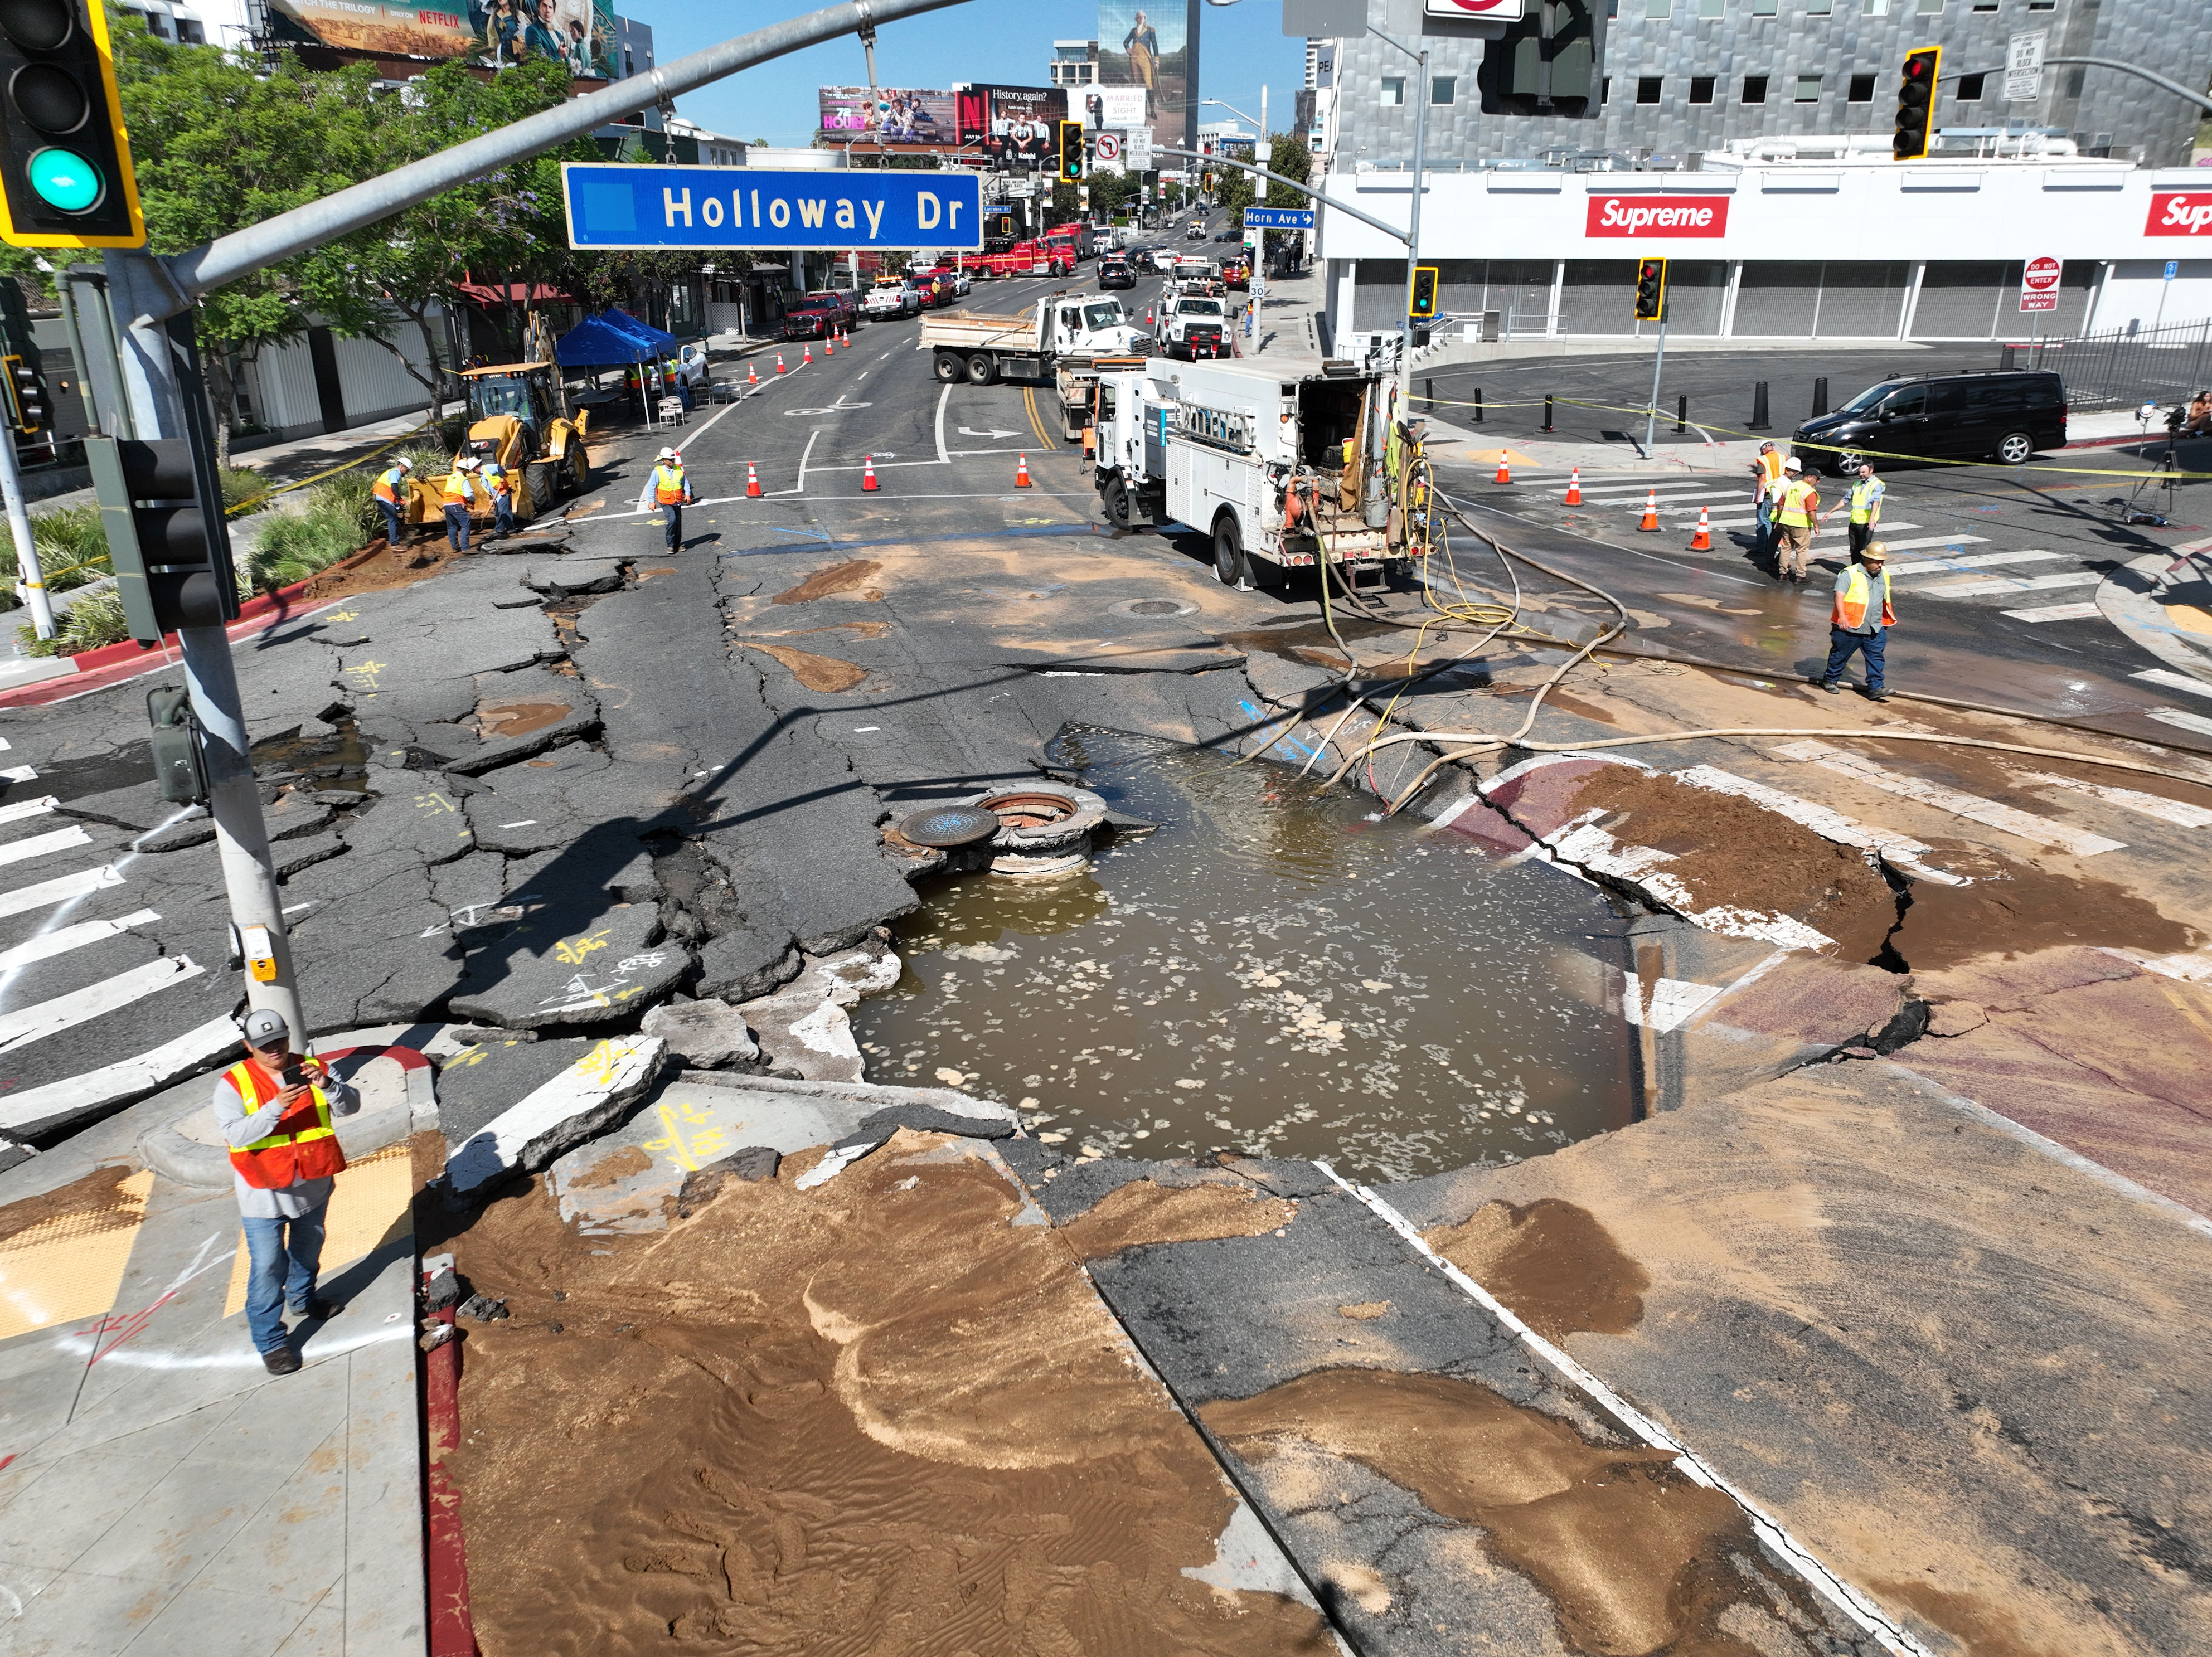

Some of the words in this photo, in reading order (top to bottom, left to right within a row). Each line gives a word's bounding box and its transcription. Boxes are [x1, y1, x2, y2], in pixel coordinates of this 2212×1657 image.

[319, 0, 338, 9] THE
[338, 2, 376, 15] TRILOGY
[419, 9, 460, 29] NETFLIX
[2016, 50, 2023, 59] DO
[2026, 47, 2036, 56] NOT
[2016, 58, 2032, 68] BLOCK
[2007, 66, 2038, 78] INTERSECTION
[993, 89, 1022, 101] History,
[1023, 91, 1047, 102] again?
[836, 108, 852, 117] 72
[963, 96, 981, 130] N
[663, 187, 885, 239] Holloway
[918, 191, 963, 230] Dr
[1246, 212, 1272, 223] Horn
[1278, 213, 1298, 225] Ave
[1600, 198, 1713, 234] Supreme
